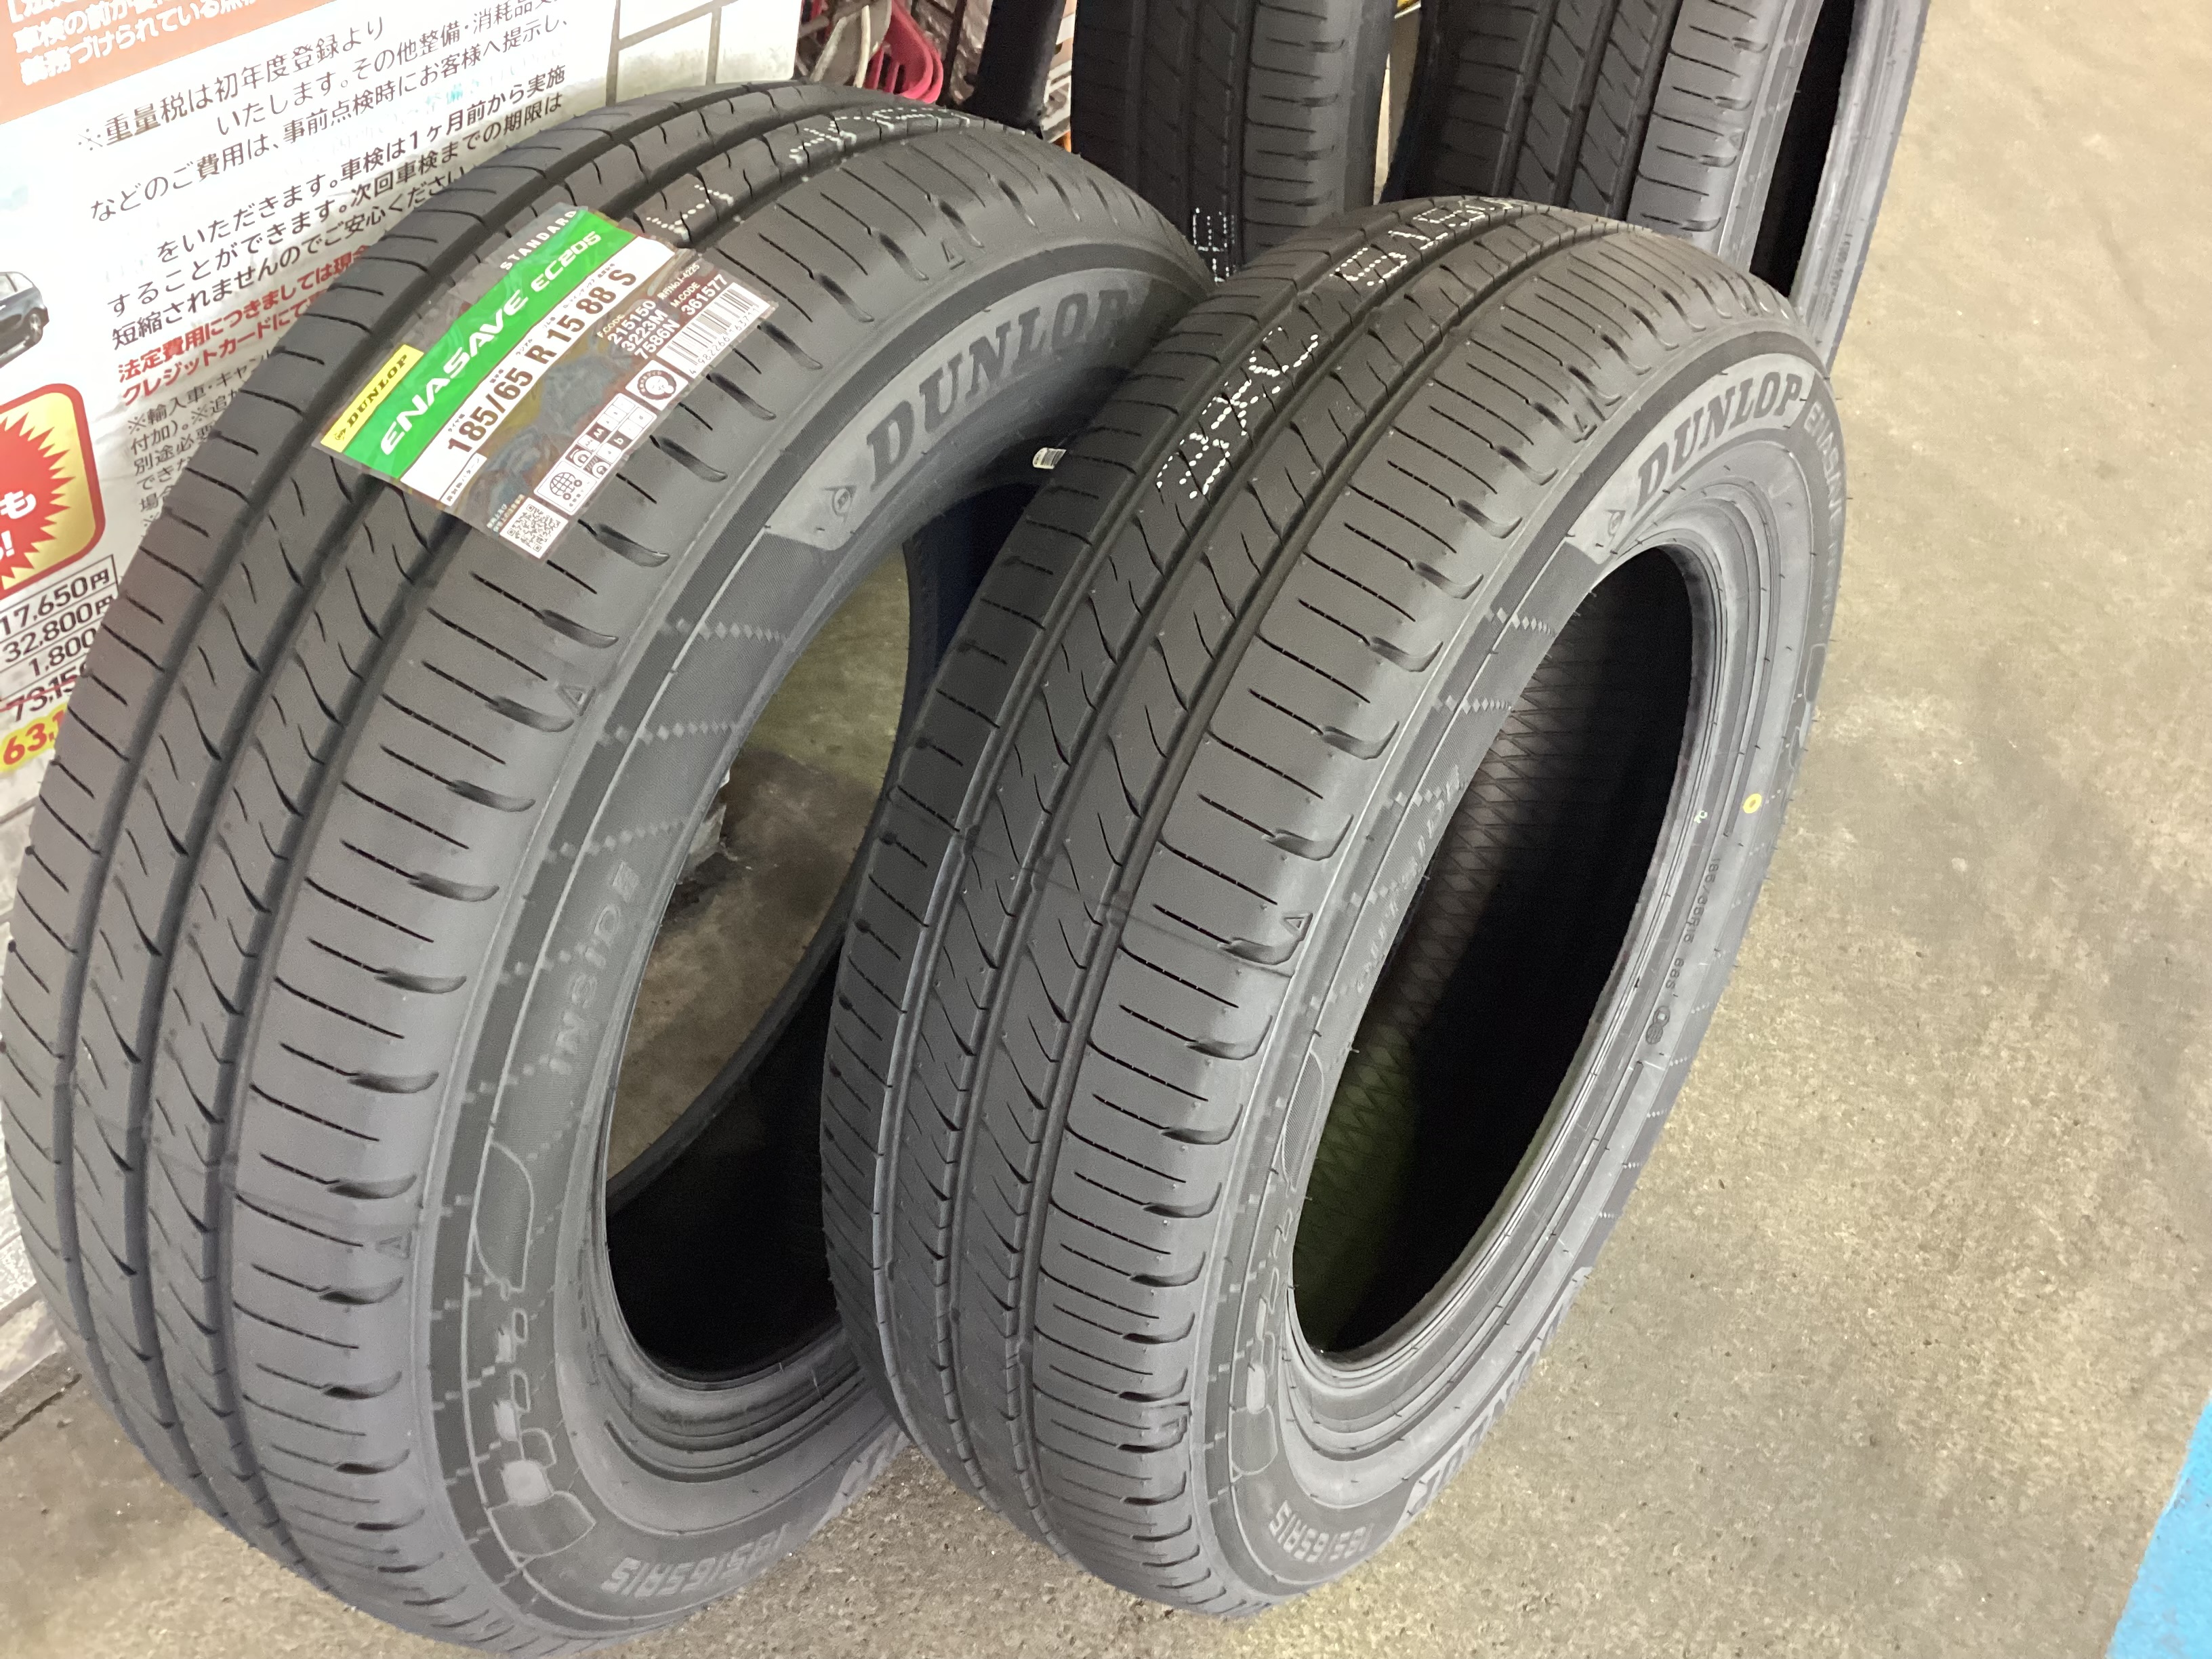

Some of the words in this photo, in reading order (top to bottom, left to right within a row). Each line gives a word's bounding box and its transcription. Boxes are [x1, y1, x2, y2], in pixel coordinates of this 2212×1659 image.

[499, 209, 576, 272] STANDARD
[607, 300, 657, 345] 215150
[670, 281, 701, 308] M.CODE
[680, 273, 728, 316] 361577
[122, 289, 327, 406] クレジットカードにて
[447, 367, 533, 452] 185/65
[524, 344, 558, 365] R
[547, 314, 586, 343] 15
[575, 286, 617, 314] 88
[608, 268, 636, 287] S
[621, 309, 668, 352] 3223M
[634, 318, 681, 360] 7586N
[346, 353, 409, 428] DUNLOP
[380, 289, 529, 455] ENASAVE
[866, 289, 1130, 492] DUNLOP
[593, 425, 605, 438] AA
[1630, 371, 1803, 521] DUNLOP
